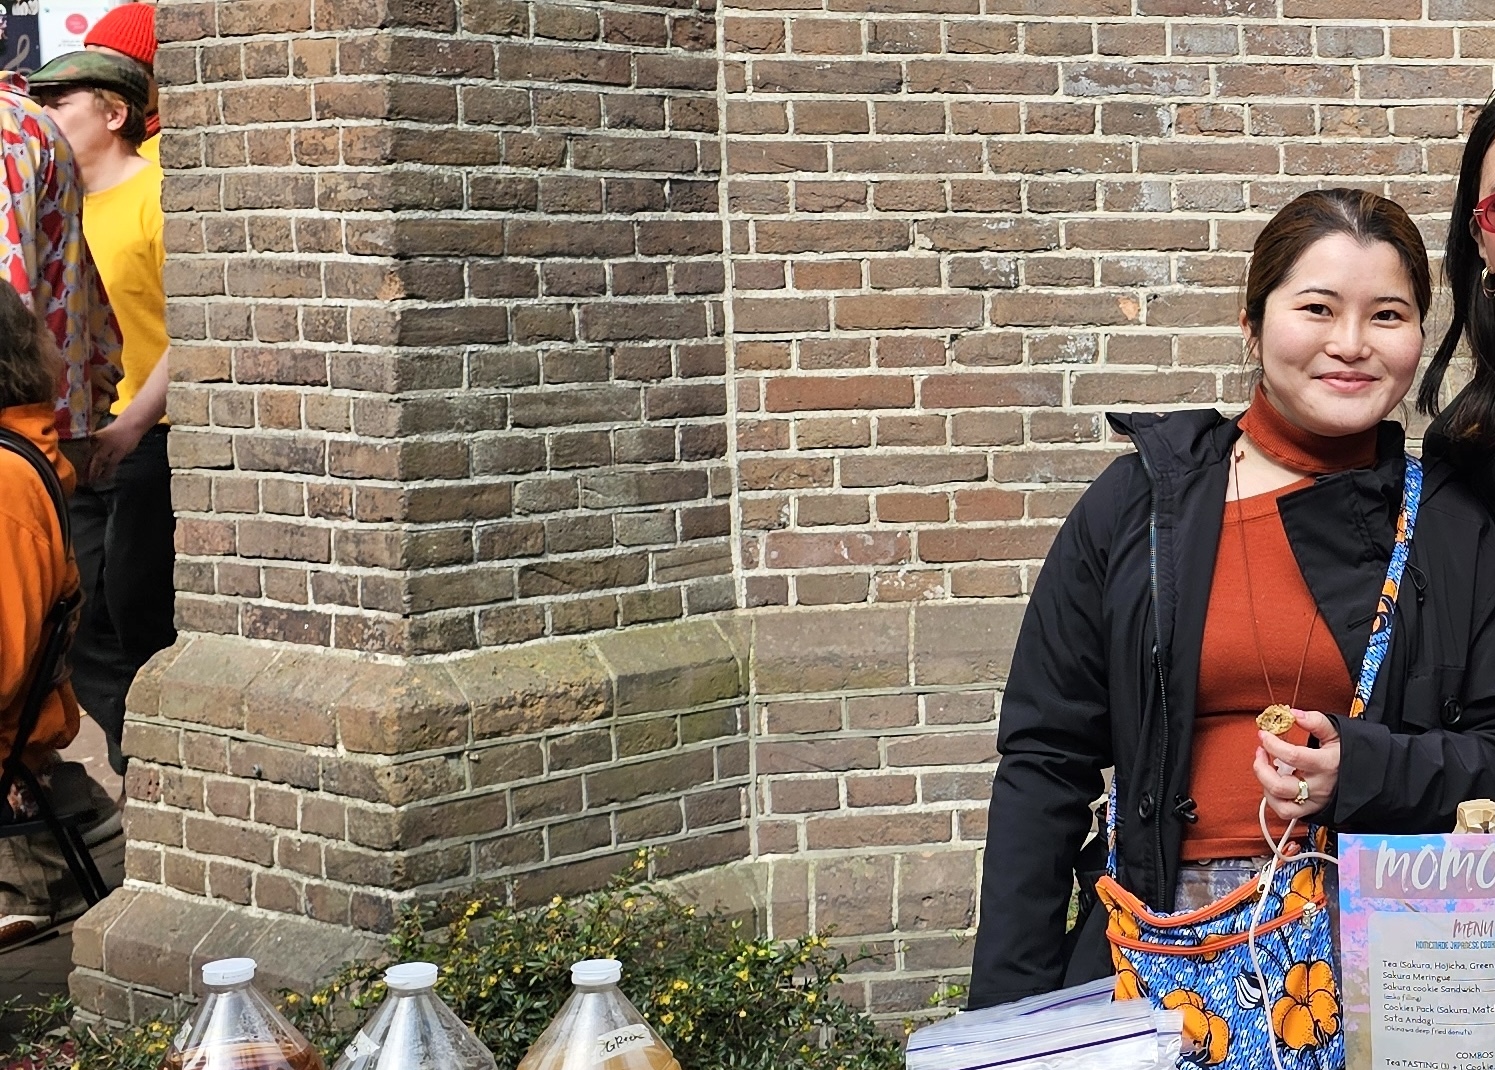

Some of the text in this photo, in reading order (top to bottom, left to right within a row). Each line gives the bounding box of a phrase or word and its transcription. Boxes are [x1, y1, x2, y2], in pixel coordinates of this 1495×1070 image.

[1452, 920, 1494, 938] MENU
[1383, 972, 1450, 982] Sakura Meringue
[1383, 983, 1411, 991] Sakura
[1405, 1016, 1434, 1025] Andagi
[1402, 1060, 1438, 1069] TASTING
[1466, 1062, 1493, 1070] Cookie
